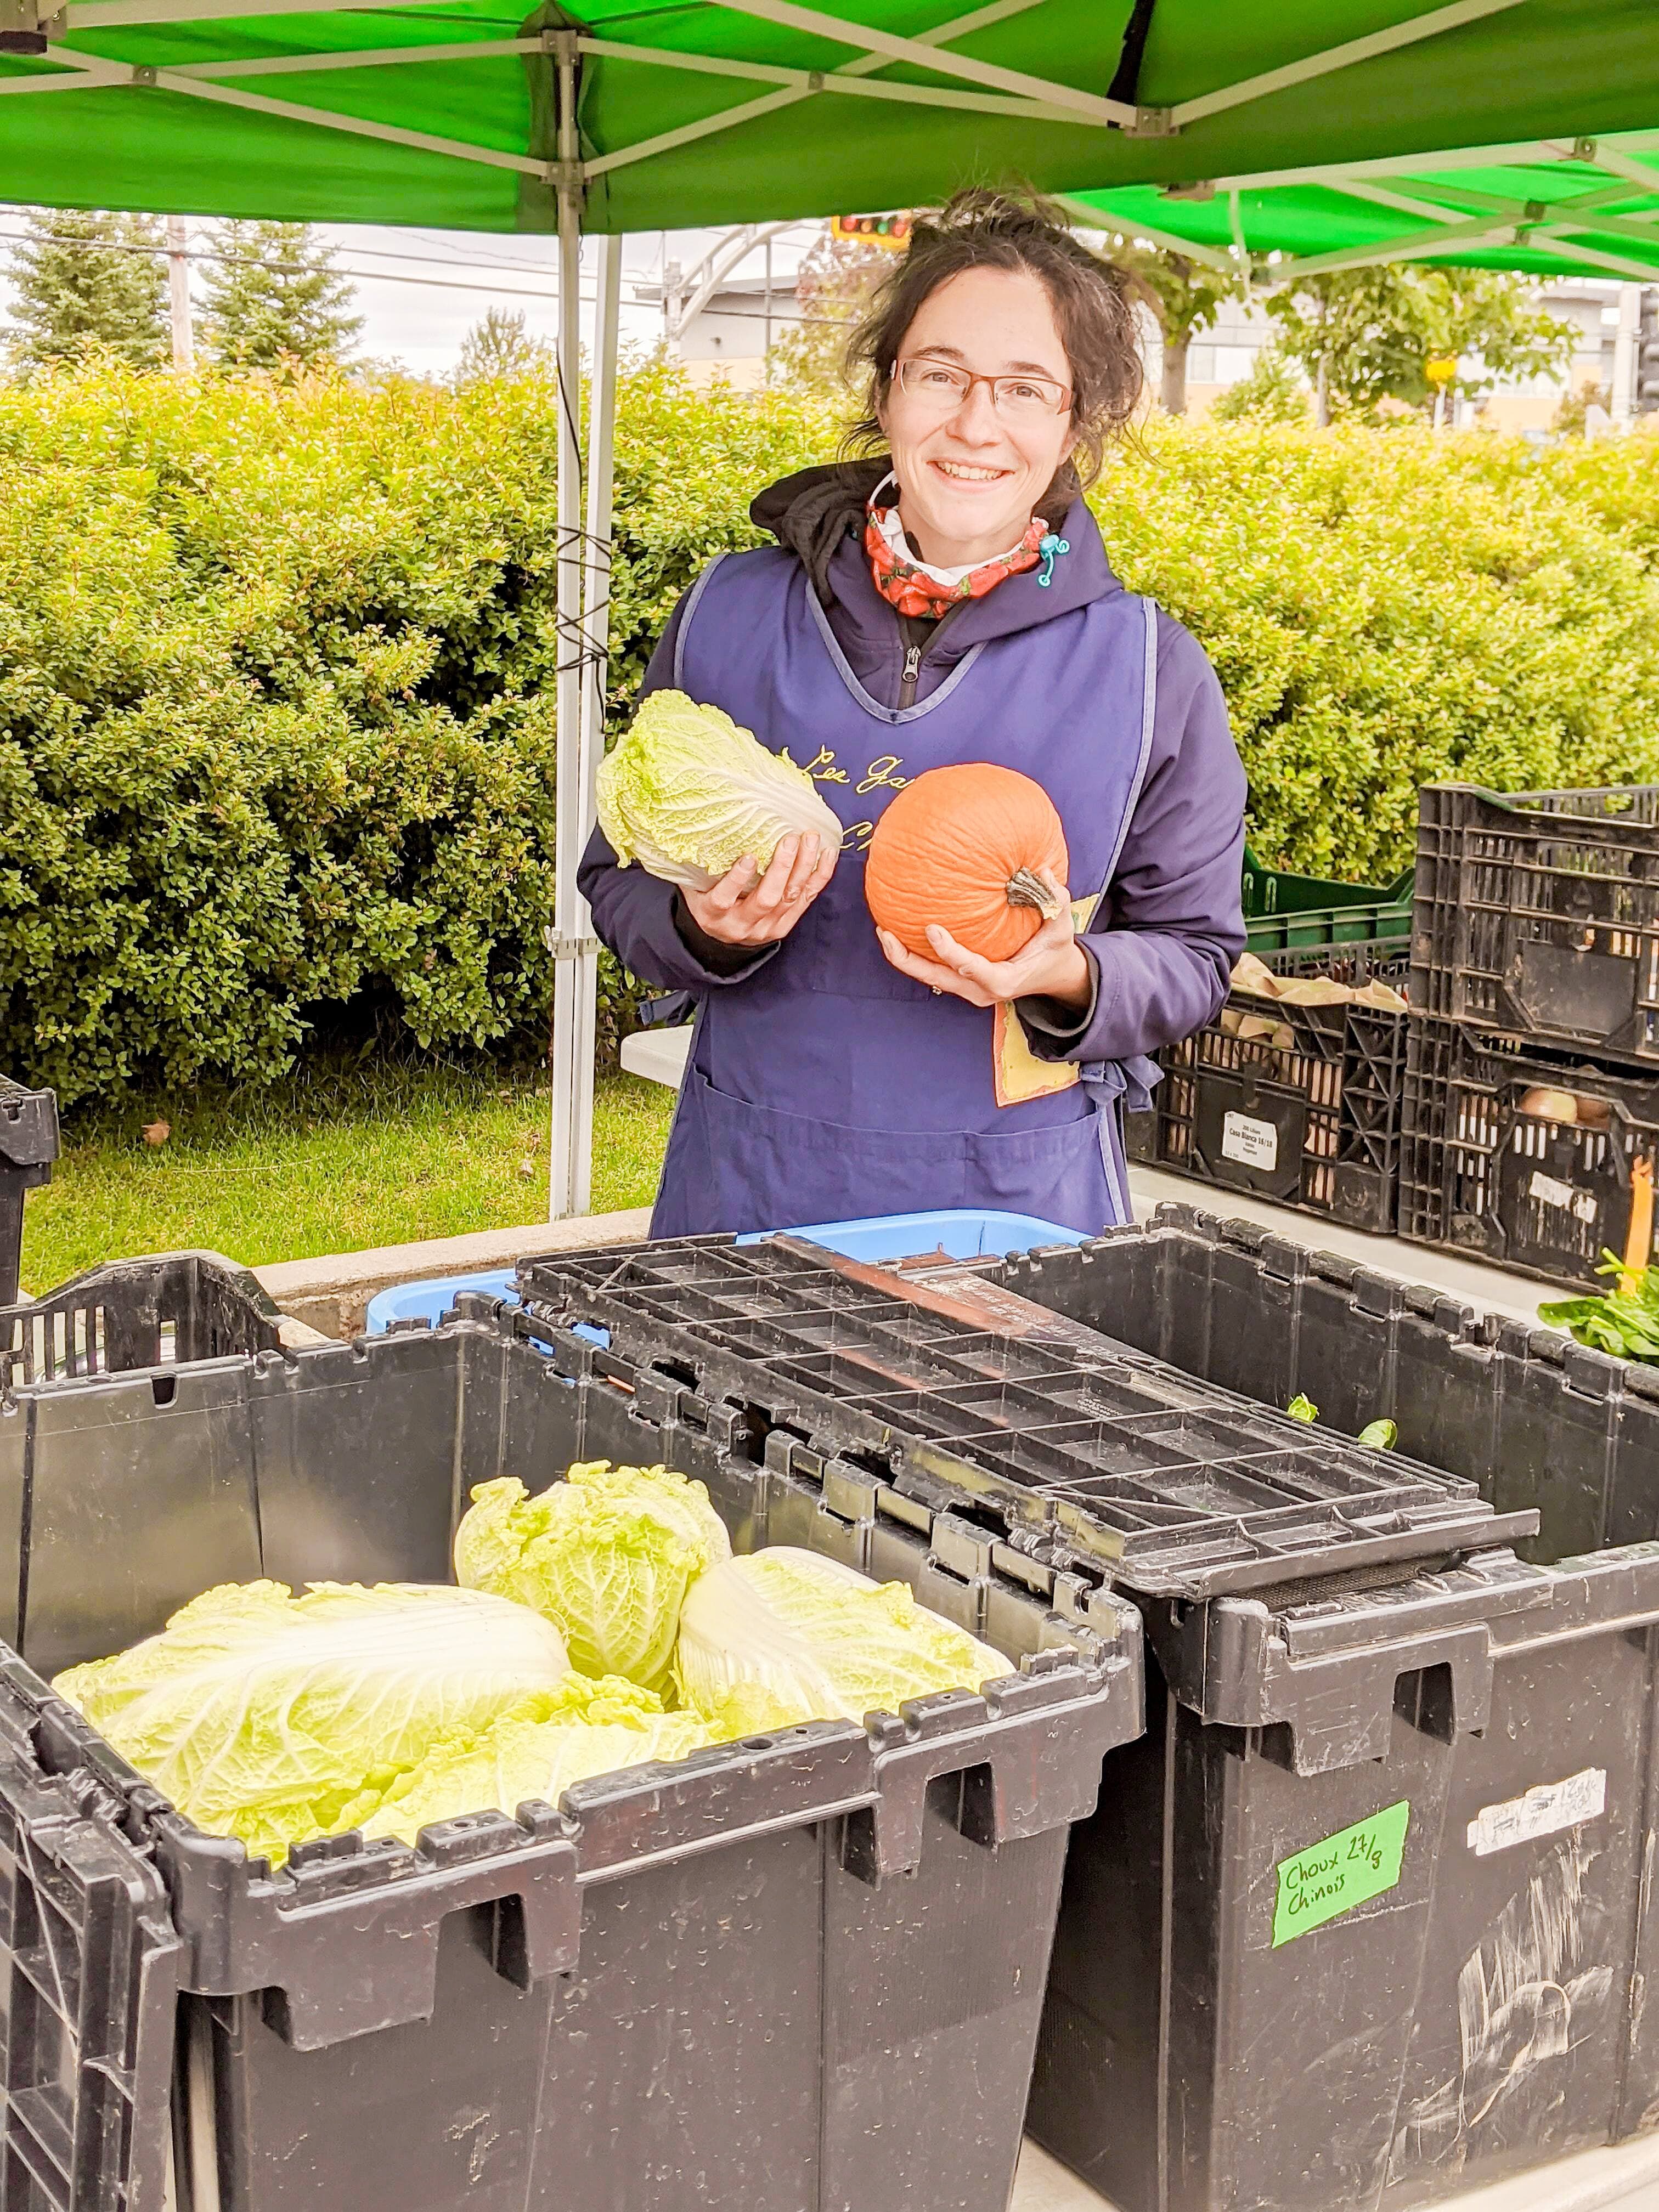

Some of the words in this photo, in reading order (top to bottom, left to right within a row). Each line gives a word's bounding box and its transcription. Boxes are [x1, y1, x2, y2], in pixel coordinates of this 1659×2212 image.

[1229, 1128, 1240, 1137] Casa
[1286, 1851, 1339, 1889] Choux
[1288, 1874, 1345, 1915] Chinois
